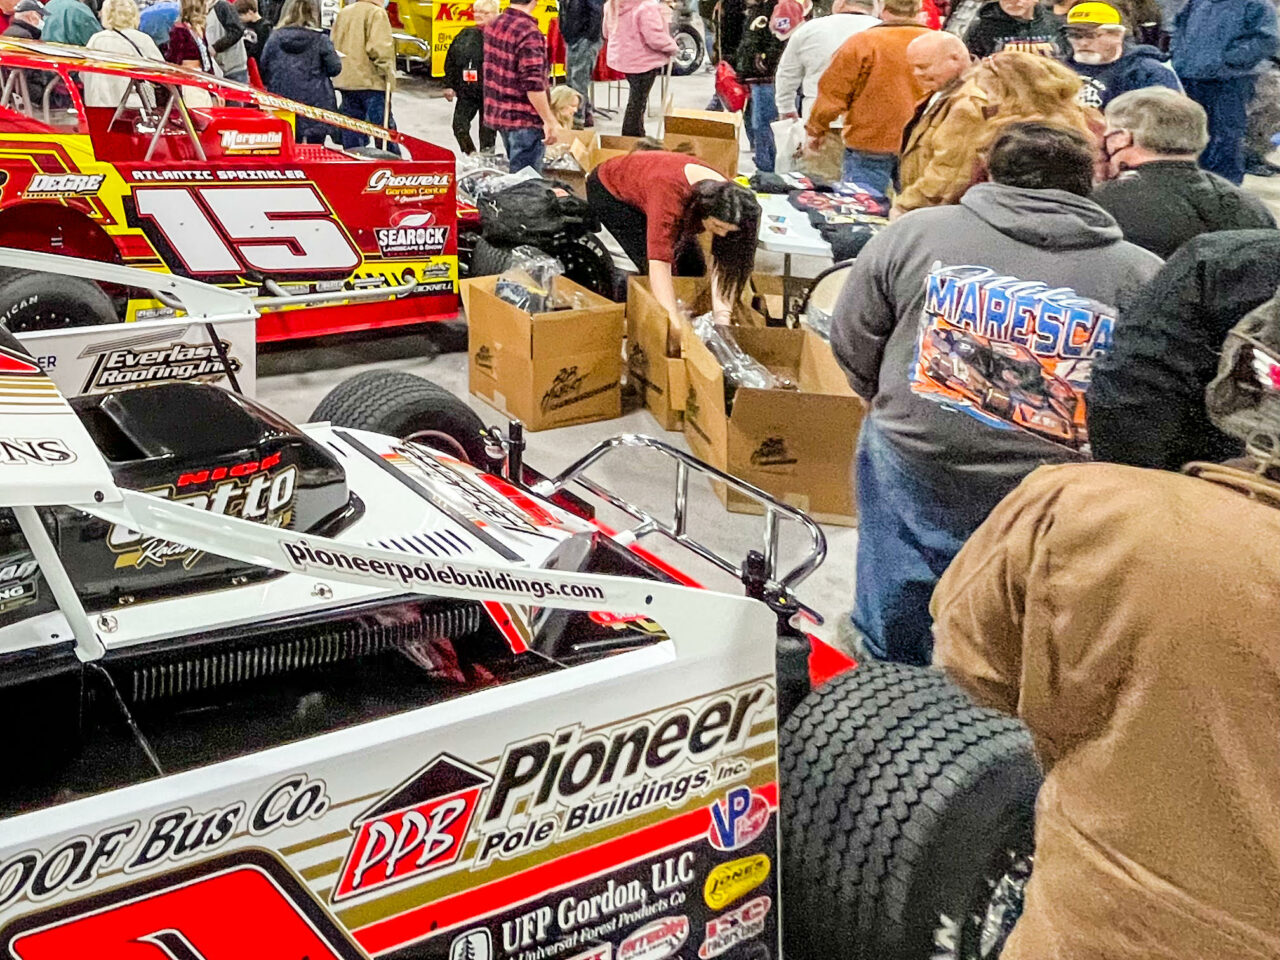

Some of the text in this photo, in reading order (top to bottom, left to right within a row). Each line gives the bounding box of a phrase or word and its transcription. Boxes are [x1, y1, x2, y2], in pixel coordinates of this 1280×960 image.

[132, 169, 307, 181] ATLANTIC SPRINKLER
[366, 169, 450, 191] Growers
[385, 187, 448, 196] Garden Center
[134, 187, 364, 274] 15
[378, 227, 445, 247] SEAROCK
[925, 274, 1116, 359] MARESCA
[106, 340, 230, 370] Everlast
[176, 451, 282, 487] NICK
[285, 540, 605, 600] pioneerpolebuildings.com
[485, 687, 766, 823] Pioneer
[129, 806, 243, 869] Bus
[252, 777, 328, 831] Co.
[481, 760, 748, 862] Pole Buildings, Inc.
[711, 788, 751, 848] VP
[352, 797, 469, 888] PPB
[502, 851, 696, 952] UFP Gordon, LLC
[669, 890, 687, 907] Co
